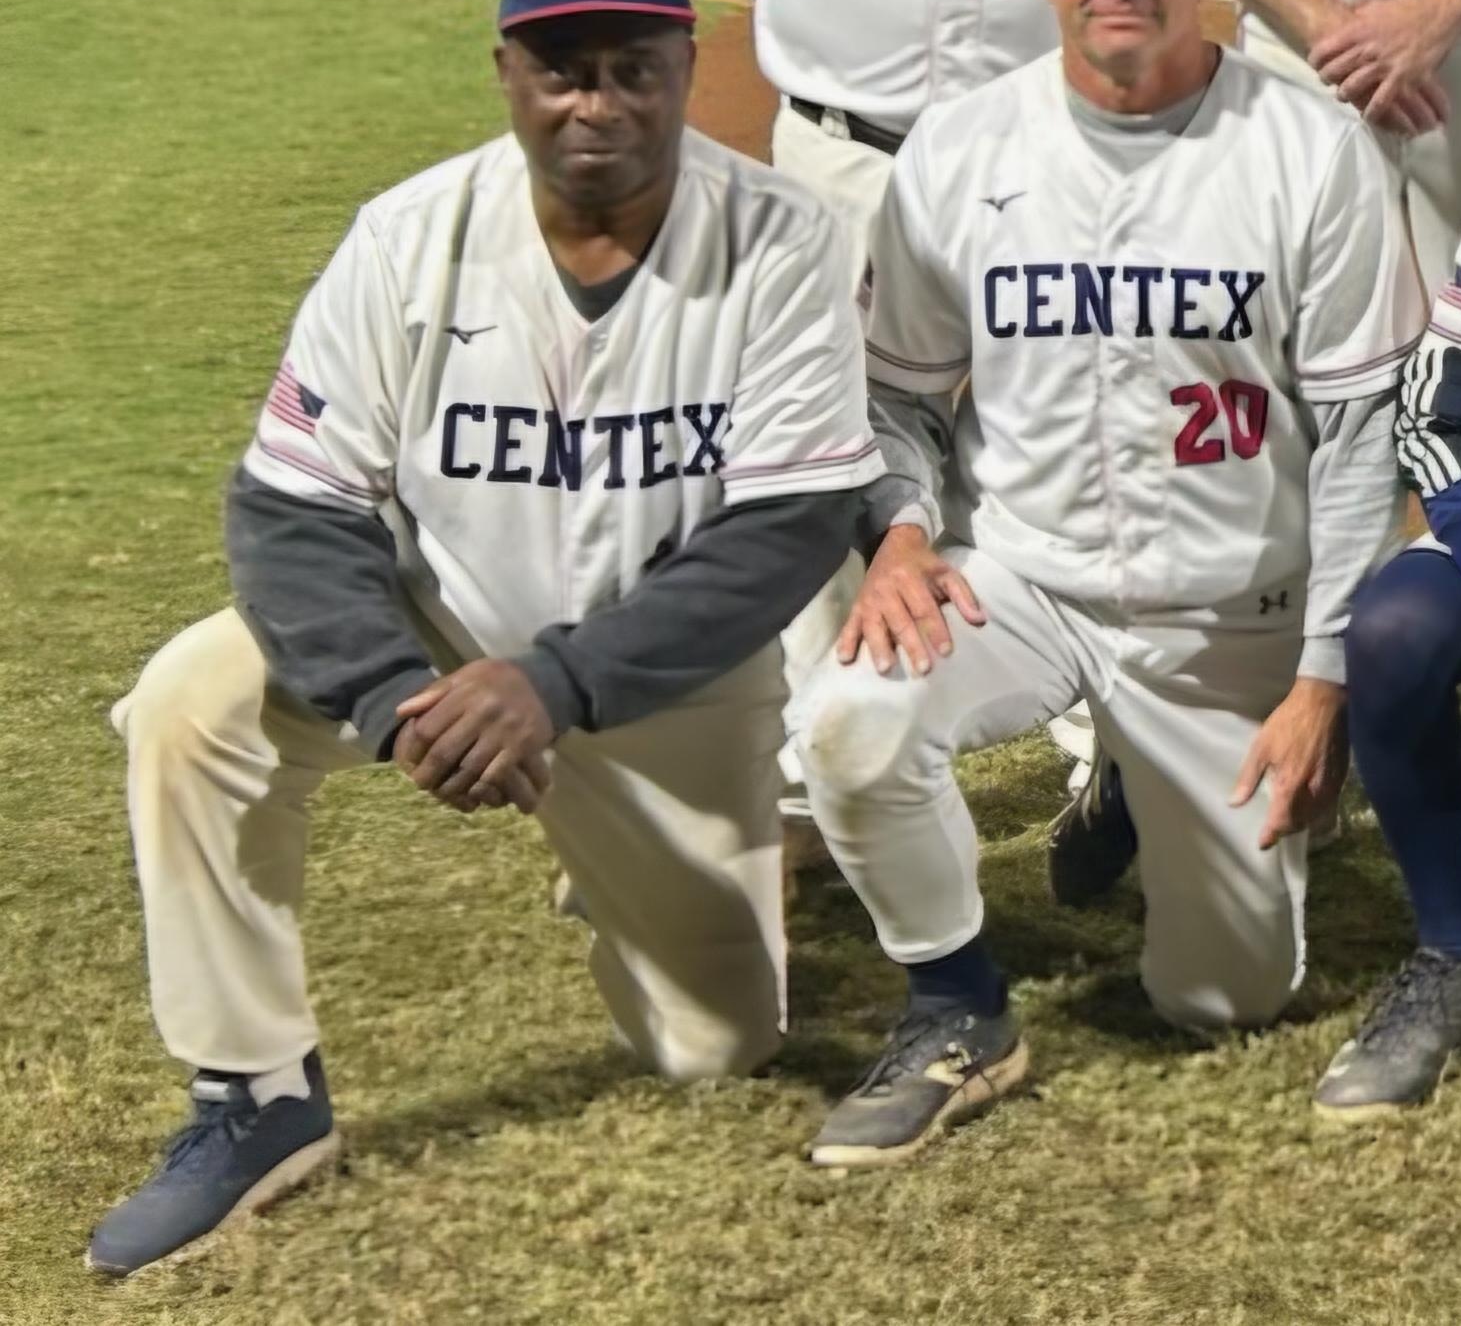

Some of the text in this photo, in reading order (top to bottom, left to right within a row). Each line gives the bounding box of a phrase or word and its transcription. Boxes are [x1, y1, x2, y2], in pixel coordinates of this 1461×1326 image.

[984, 262, 1267, 343] CENTEX
[440, 402, 730, 492] CENTEX
[1169, 378, 1270, 467] 20
